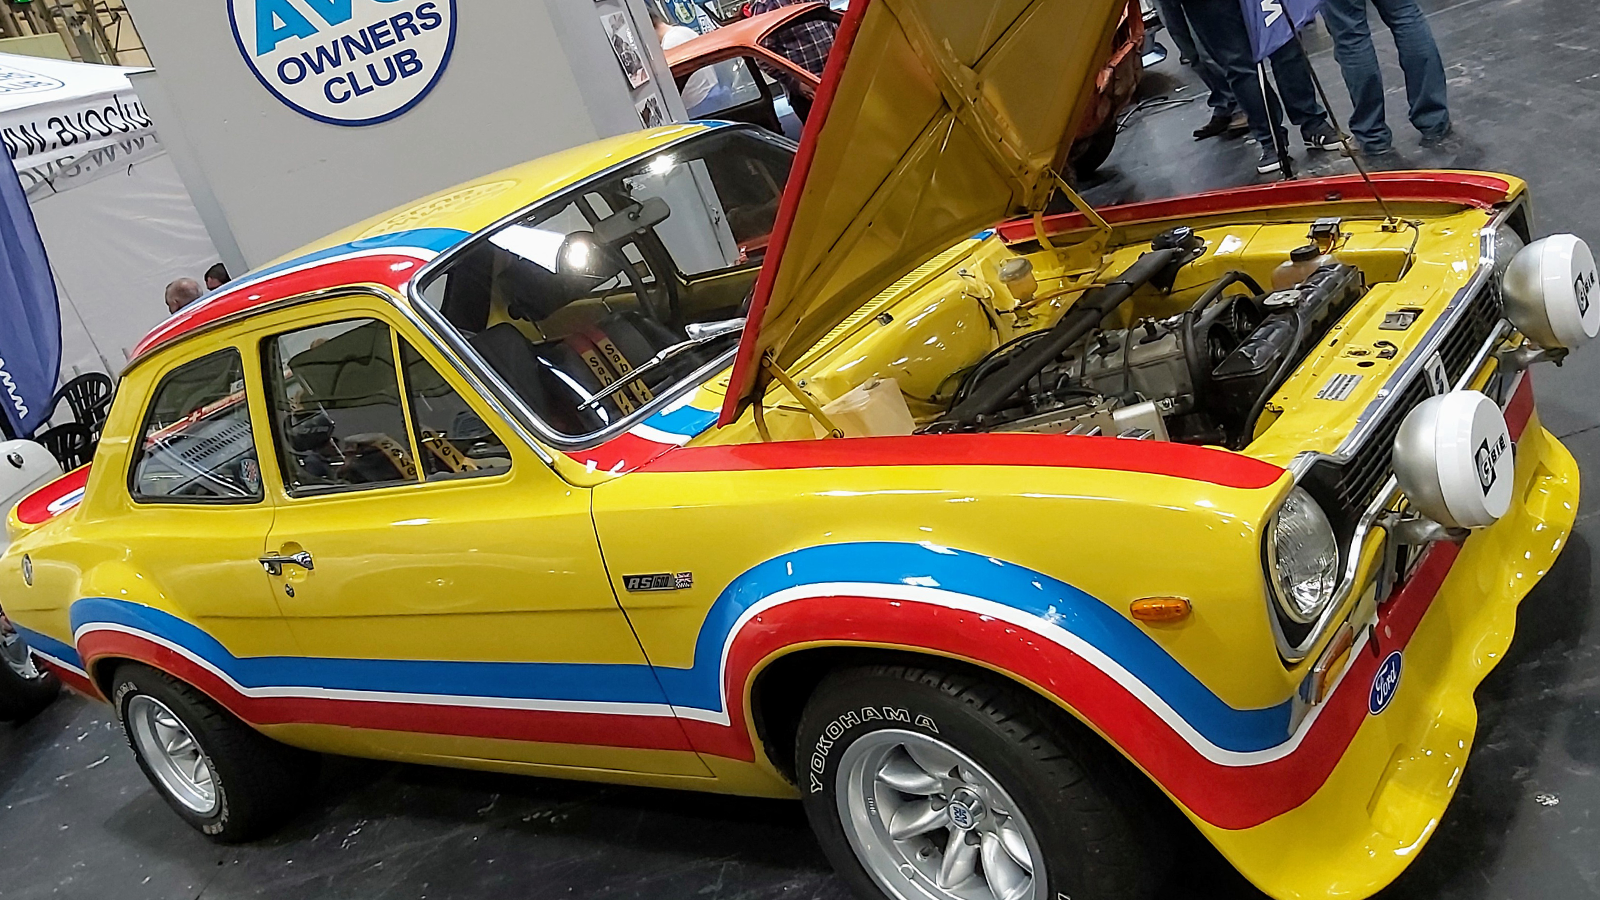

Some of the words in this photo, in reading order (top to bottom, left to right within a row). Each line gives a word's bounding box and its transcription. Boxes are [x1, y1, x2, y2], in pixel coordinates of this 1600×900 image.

[256, 0, 402, 57] AV
[277, 2, 442, 85] OWNERS
[324, 48, 423, 104] CLUB
[627, 576, 653, 589] RS
[1375, 661, 1397, 706] Ford
[810, 706, 940, 794] YOKOHAMA
